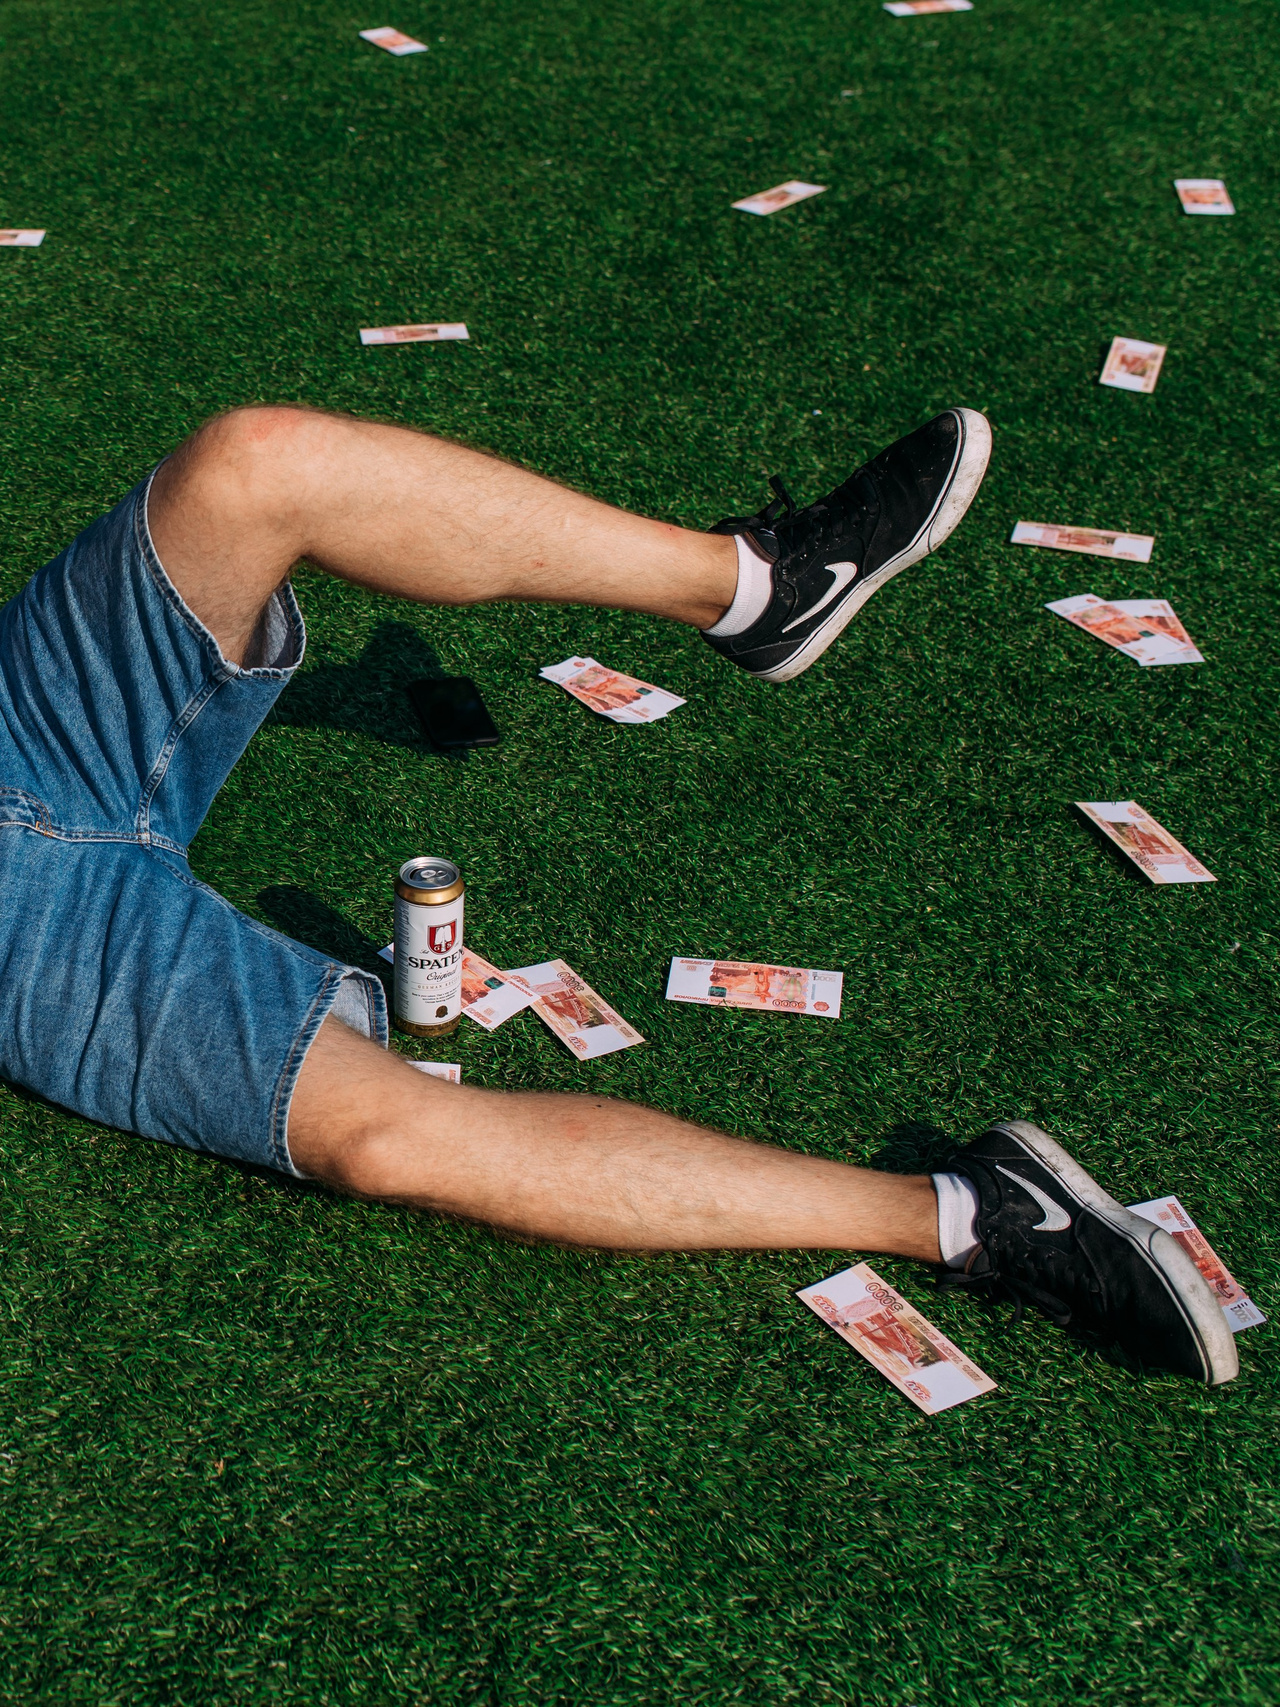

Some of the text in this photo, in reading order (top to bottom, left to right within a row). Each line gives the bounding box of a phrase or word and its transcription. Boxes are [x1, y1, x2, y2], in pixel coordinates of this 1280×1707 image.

[408, 949, 464, 969] SPATEN
[426, 966, 458, 982] Original
[865, 1282, 904, 1313] 5000
